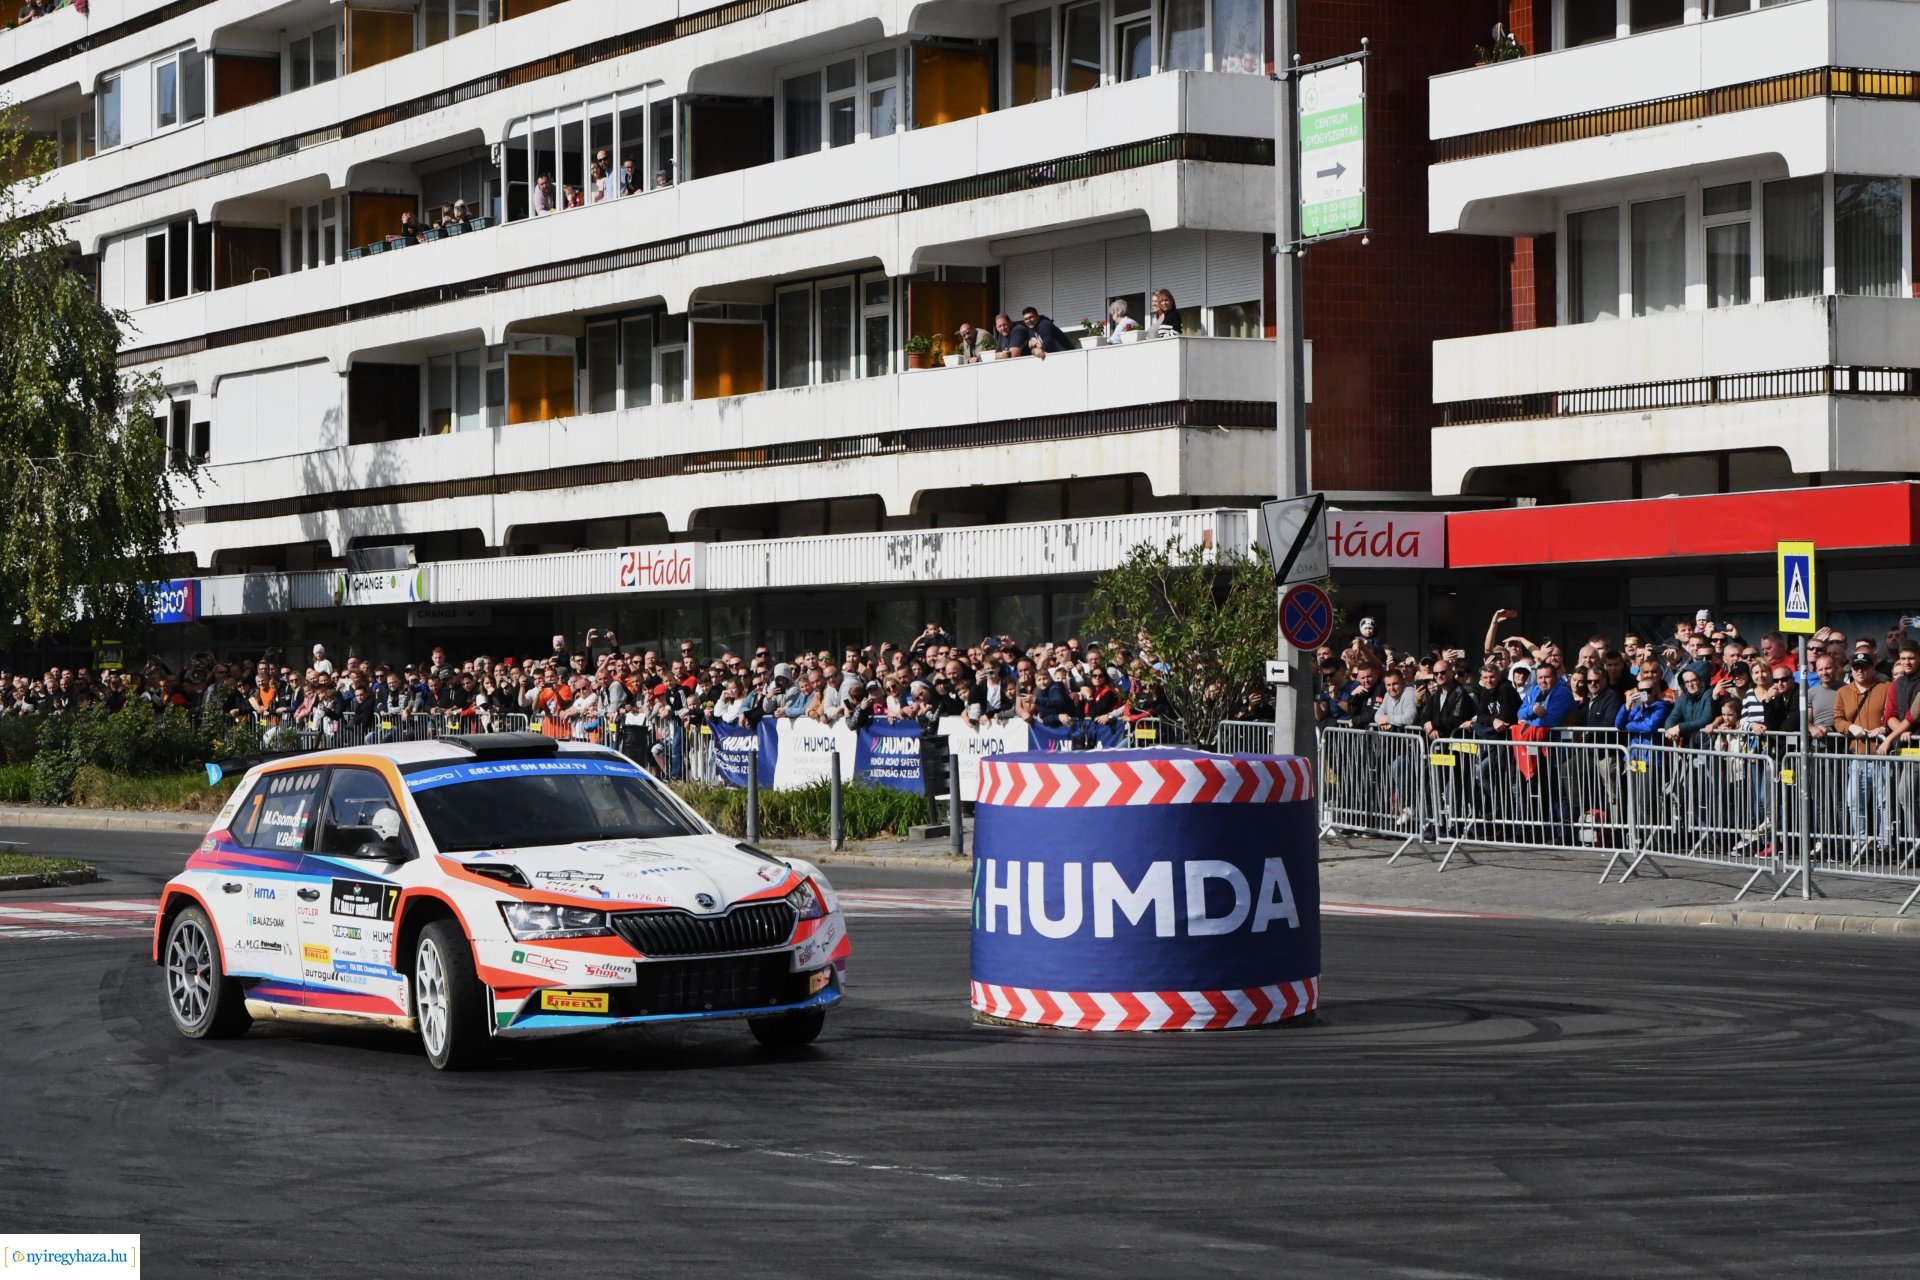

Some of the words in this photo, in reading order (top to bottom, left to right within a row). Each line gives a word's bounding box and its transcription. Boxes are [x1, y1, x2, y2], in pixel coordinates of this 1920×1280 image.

[1315, 112, 1348, 129] CENTRUM
[637, 549, 691, 586] Háda
[417, 609, 457, 618] CHANGE
[804, 737, 836, 751] HUMDA
[881, 736, 920, 754] HUMDA
[969, 738, 1005, 754] HUMDA
[468, 766, 492, 775] ERC
[493, 764, 520, 773] LIVE
[521, 763, 537, 771] ON
[901, 758, 920, 767] SAFETY
[388, 889, 398, 918] 7
[986, 857, 1299, 938] HUMDA
[297, 906, 319, 917] CUTLER
[304, 946, 329, 960] PIRELLI
[547, 995, 603, 1009] PIRELLI
